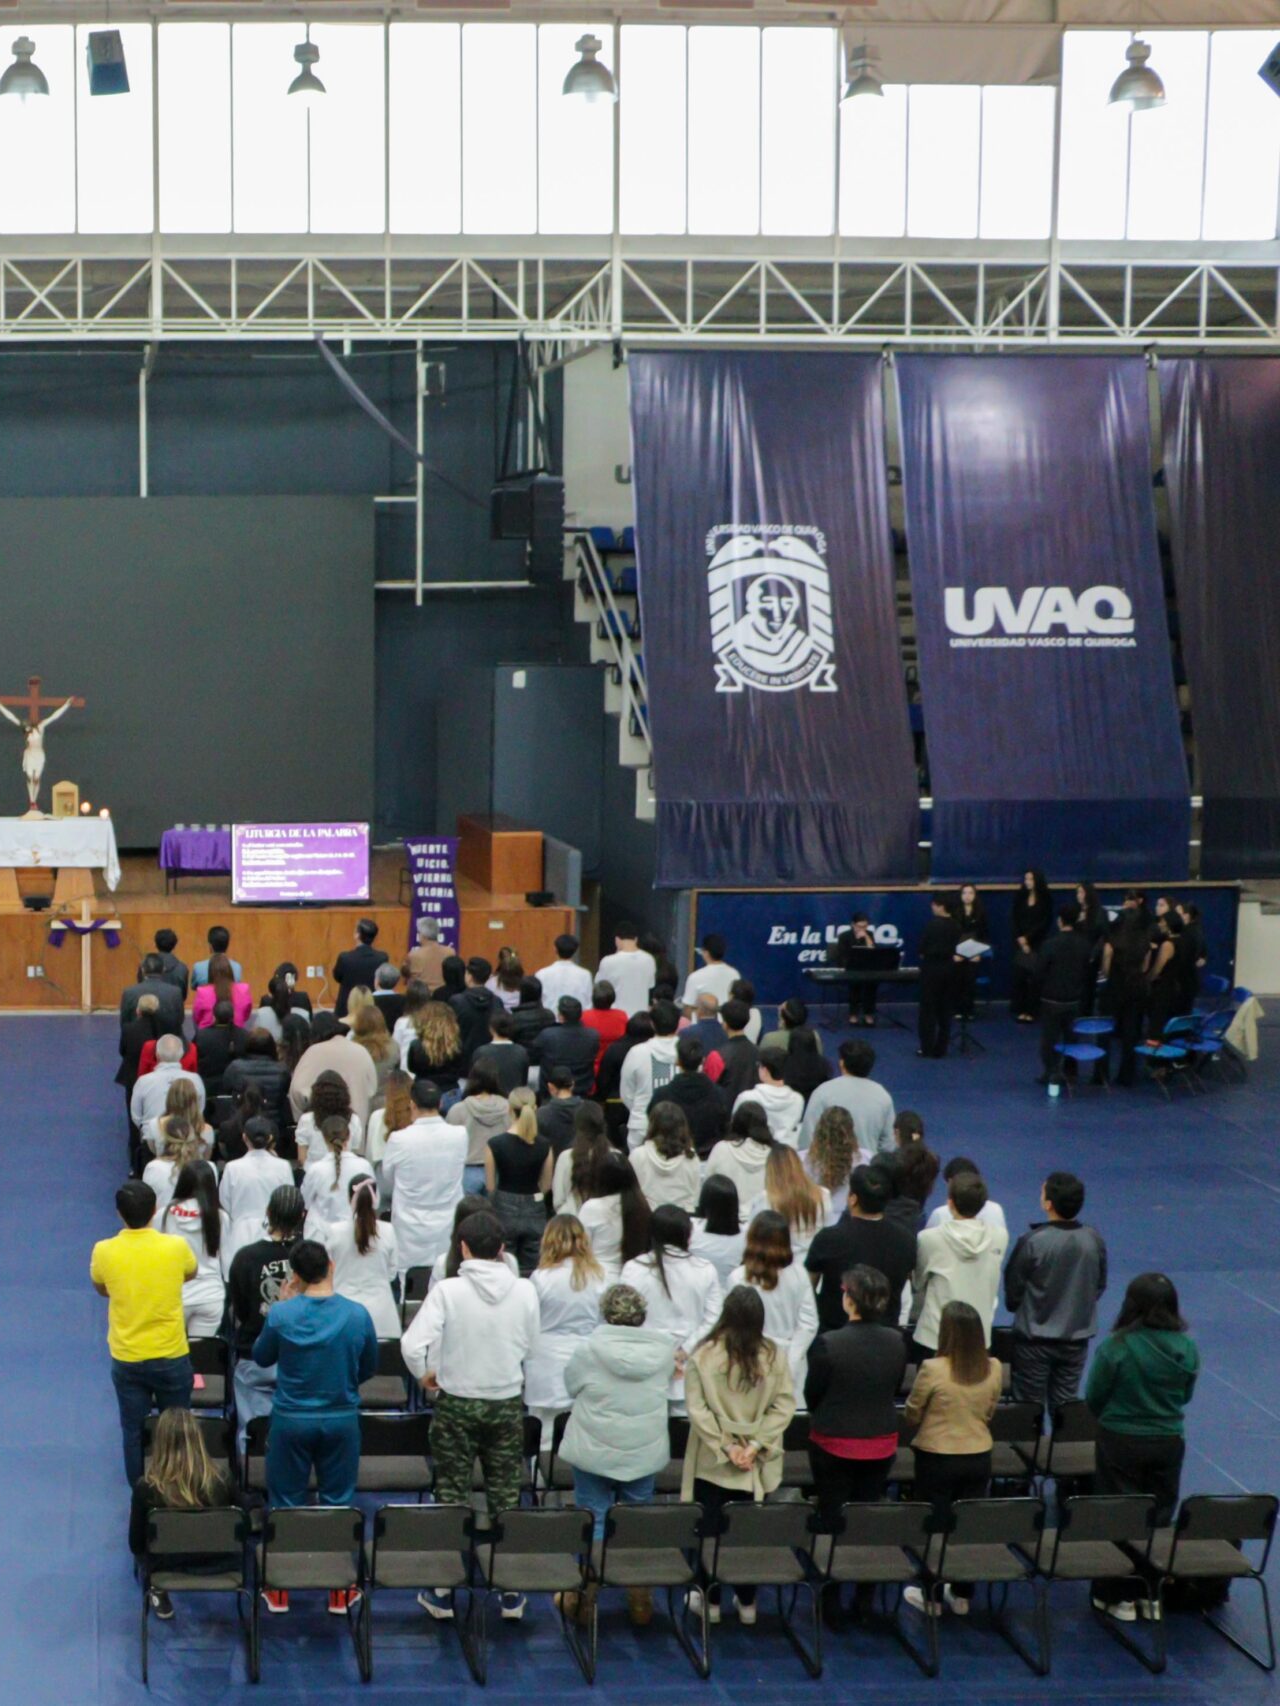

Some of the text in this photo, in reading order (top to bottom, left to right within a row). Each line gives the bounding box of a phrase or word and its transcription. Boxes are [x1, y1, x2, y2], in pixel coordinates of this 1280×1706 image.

[944, 585, 1135, 636] UVAQ
[949, 637, 1136, 648] UNIVERSIDAD VASCO DE QUIROGA
[245, 828, 358, 838] LITURGIA DE LA PALABRA
[421, 902, 441, 912] TEN
[767, 924, 904, 948] En la UQ,
[797, 949, 827, 961] ere
[260, 1259, 290, 1279] AST
